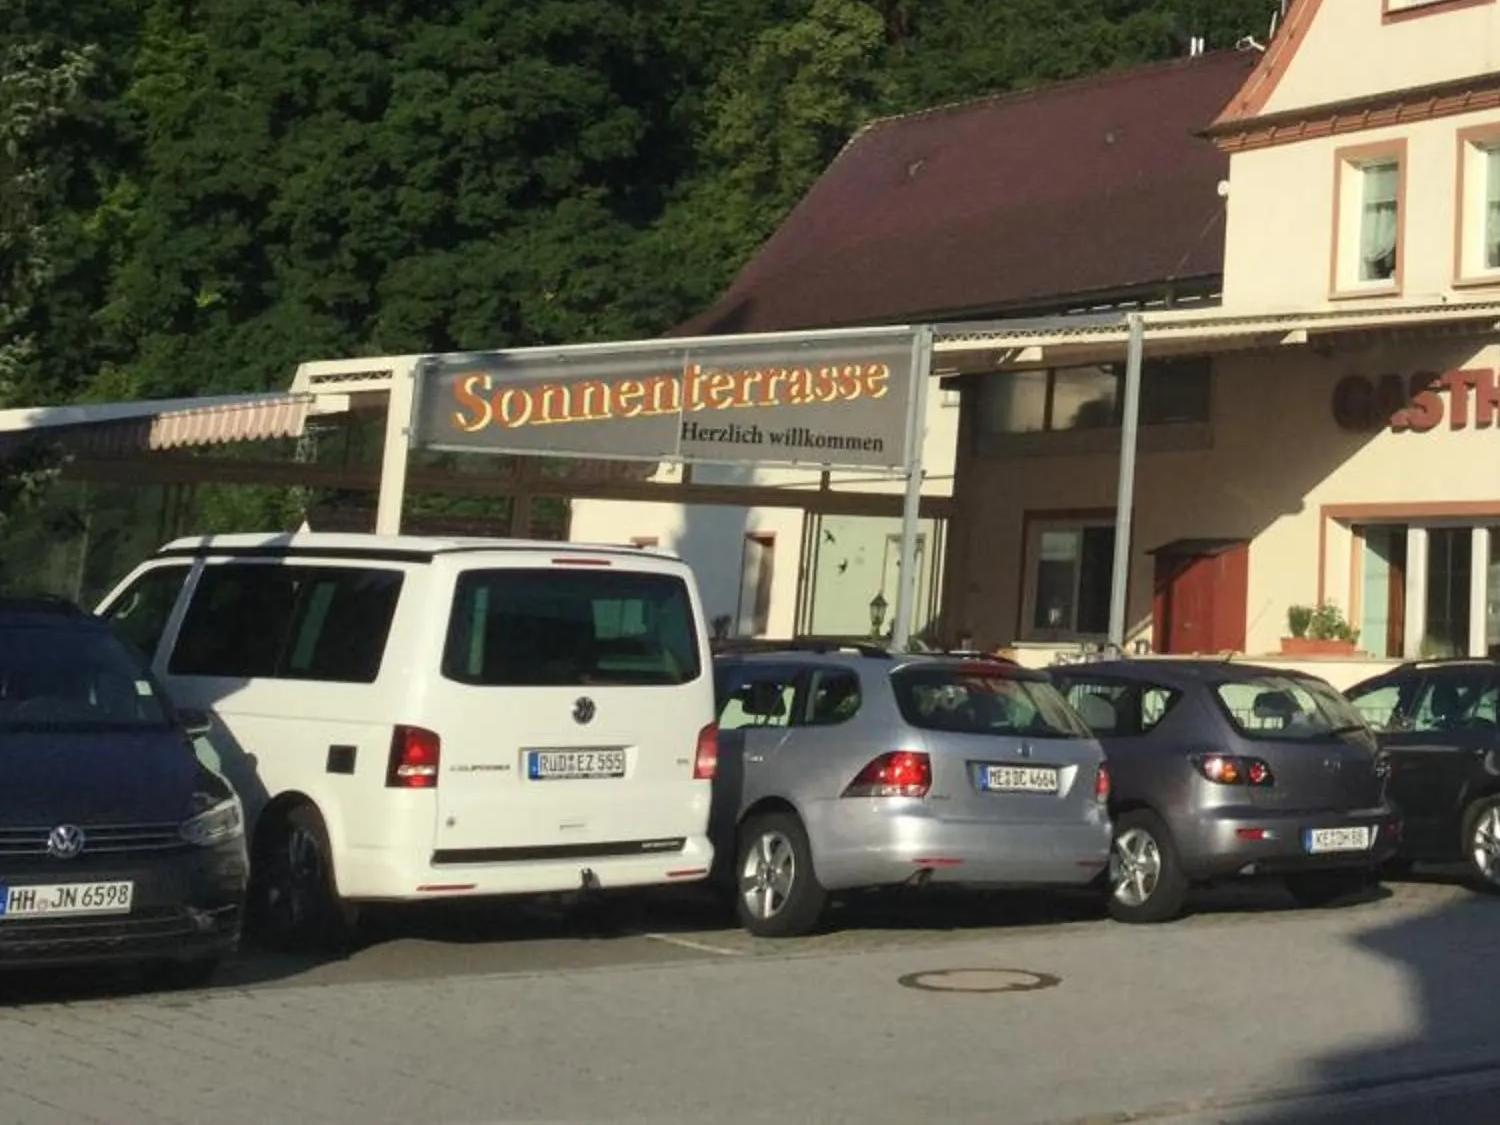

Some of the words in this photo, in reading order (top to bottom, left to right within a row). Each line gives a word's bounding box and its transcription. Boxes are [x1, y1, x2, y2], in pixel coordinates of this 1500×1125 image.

[454, 361, 891, 433] Sonnenterrasse
[681, 421, 763, 445] Herzlich
[769, 426, 884, 453] willkommen
[8, 889, 36, 911] HH
[51, 887, 78, 909] JN
[81, 884, 129, 907] 6598
